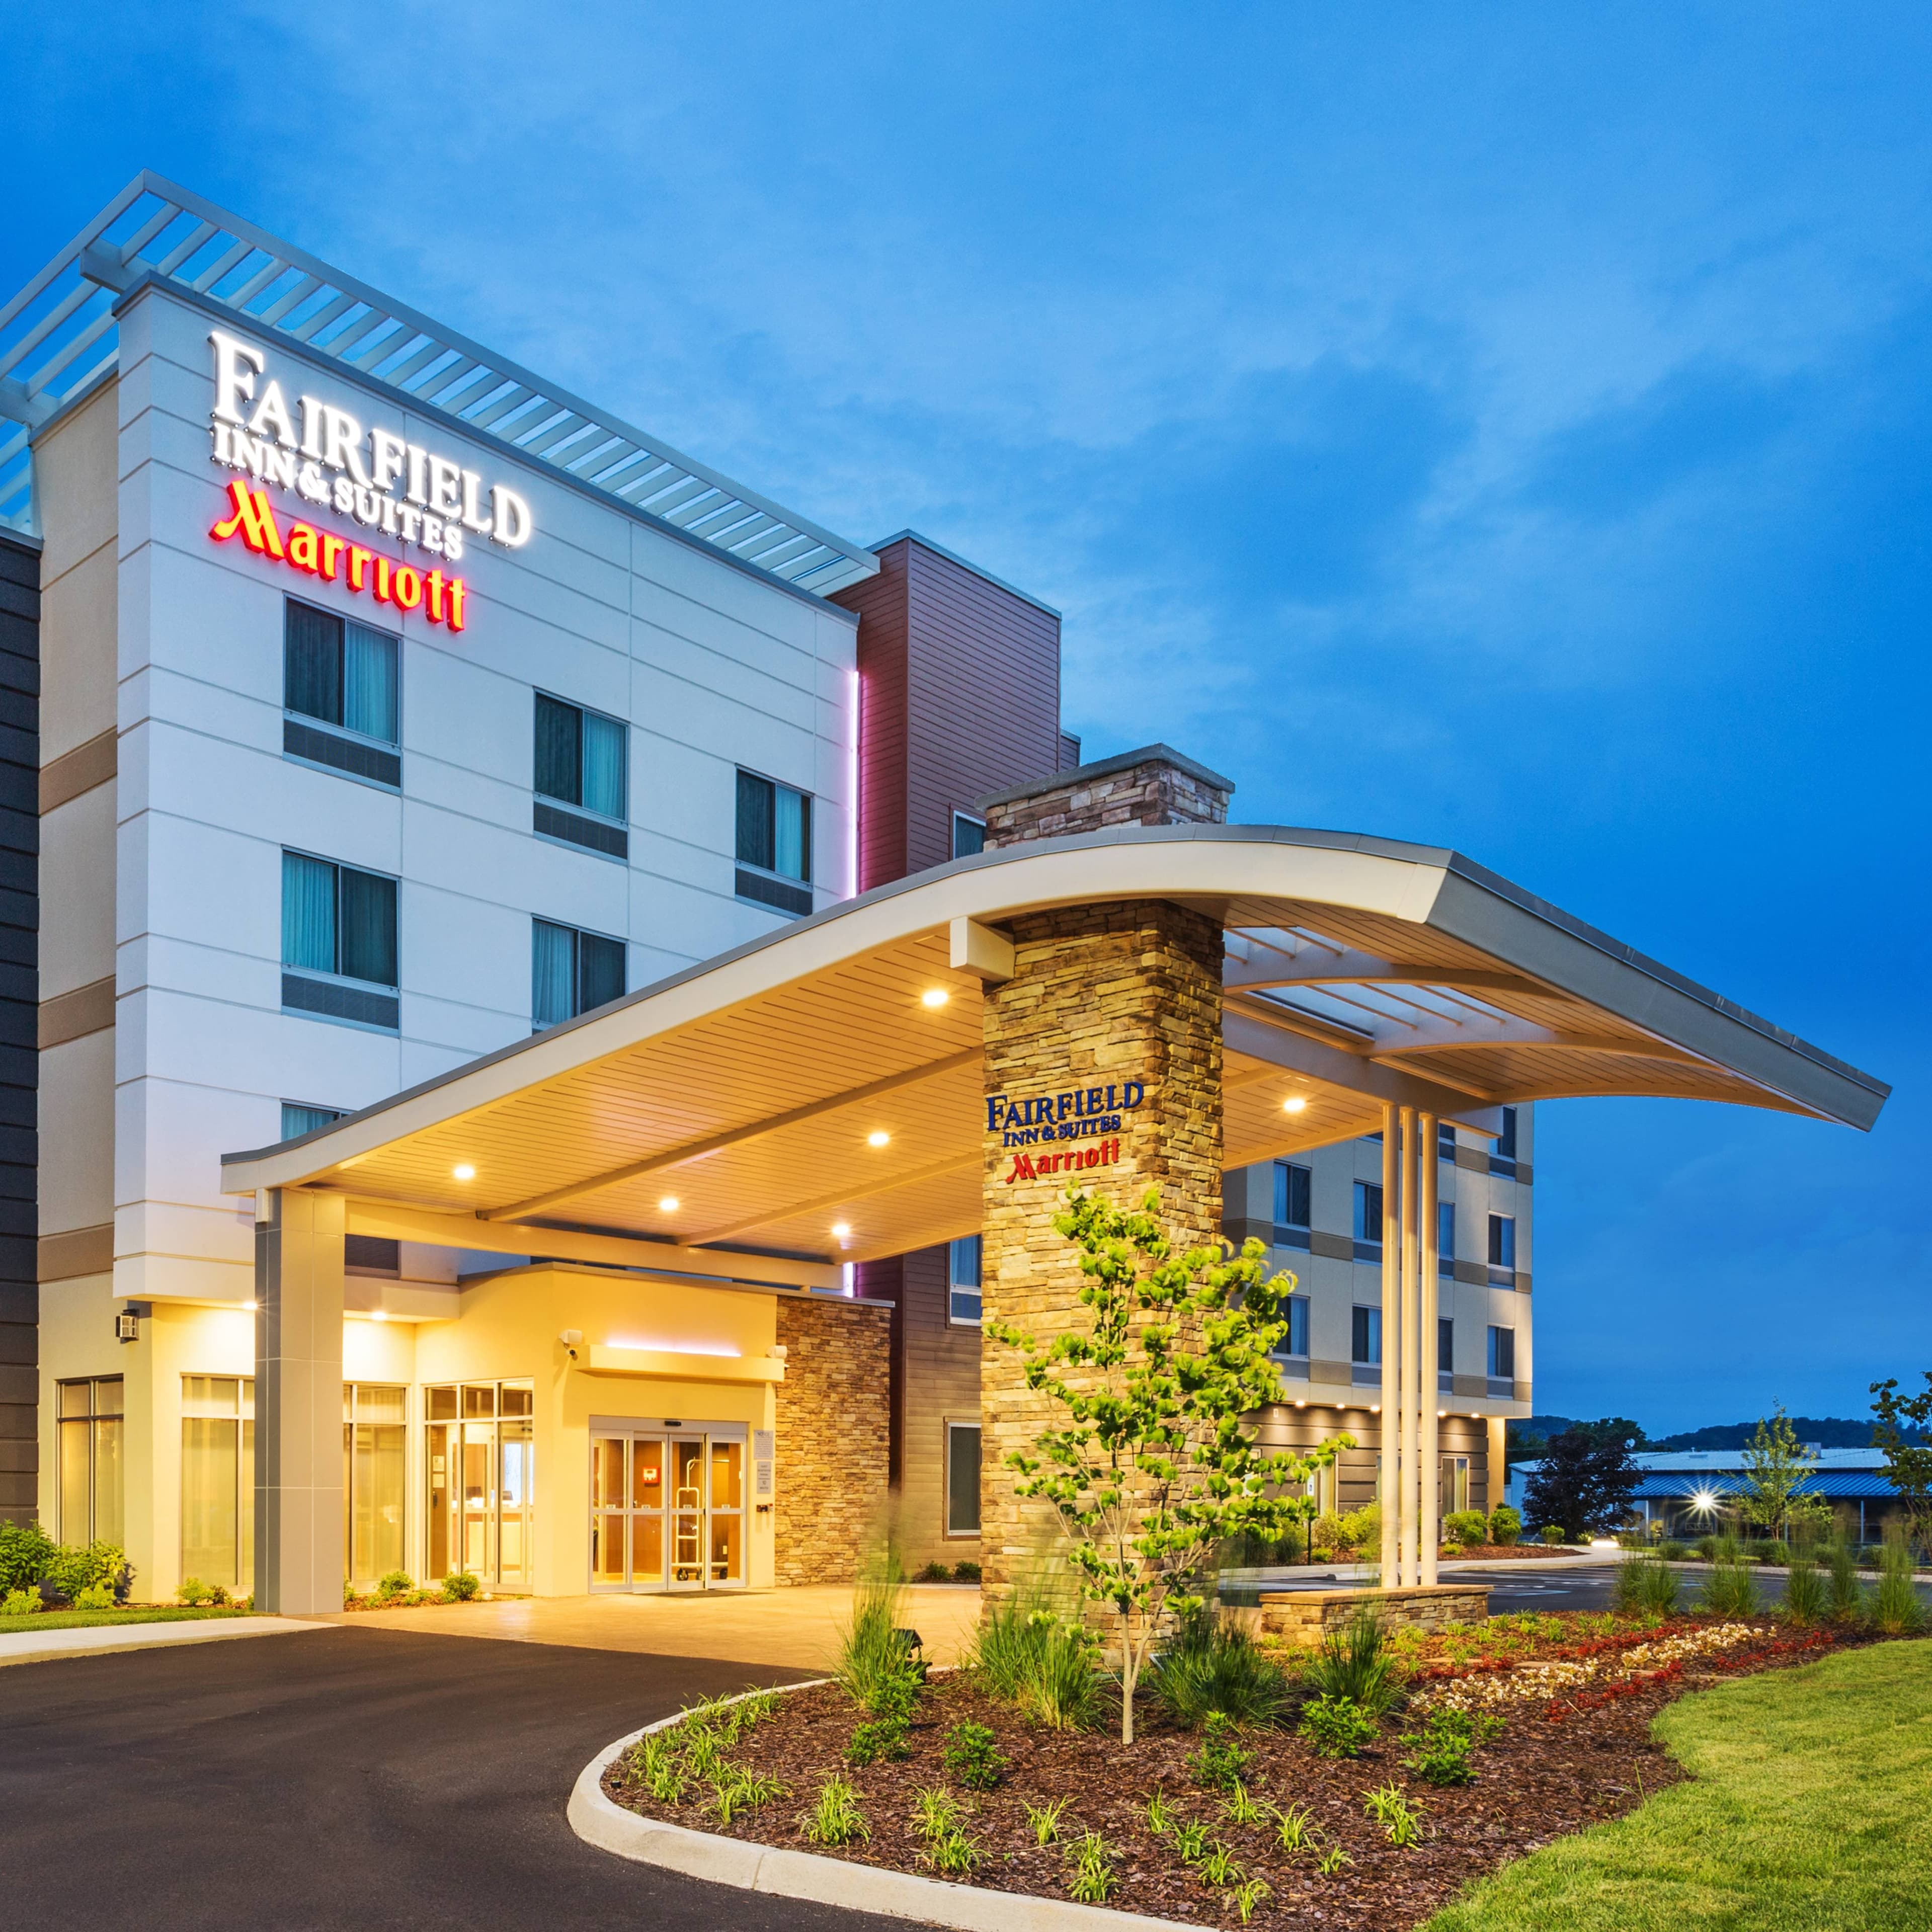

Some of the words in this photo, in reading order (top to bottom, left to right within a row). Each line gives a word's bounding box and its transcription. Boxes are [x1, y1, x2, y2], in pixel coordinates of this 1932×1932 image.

[208, 331, 531, 547] FAIRFIELD
[208, 479, 466, 633] Marriott
[985, 1082, 1144, 1132] FAIRFIELD
[1005, 1138, 1119, 1184] Marriott
